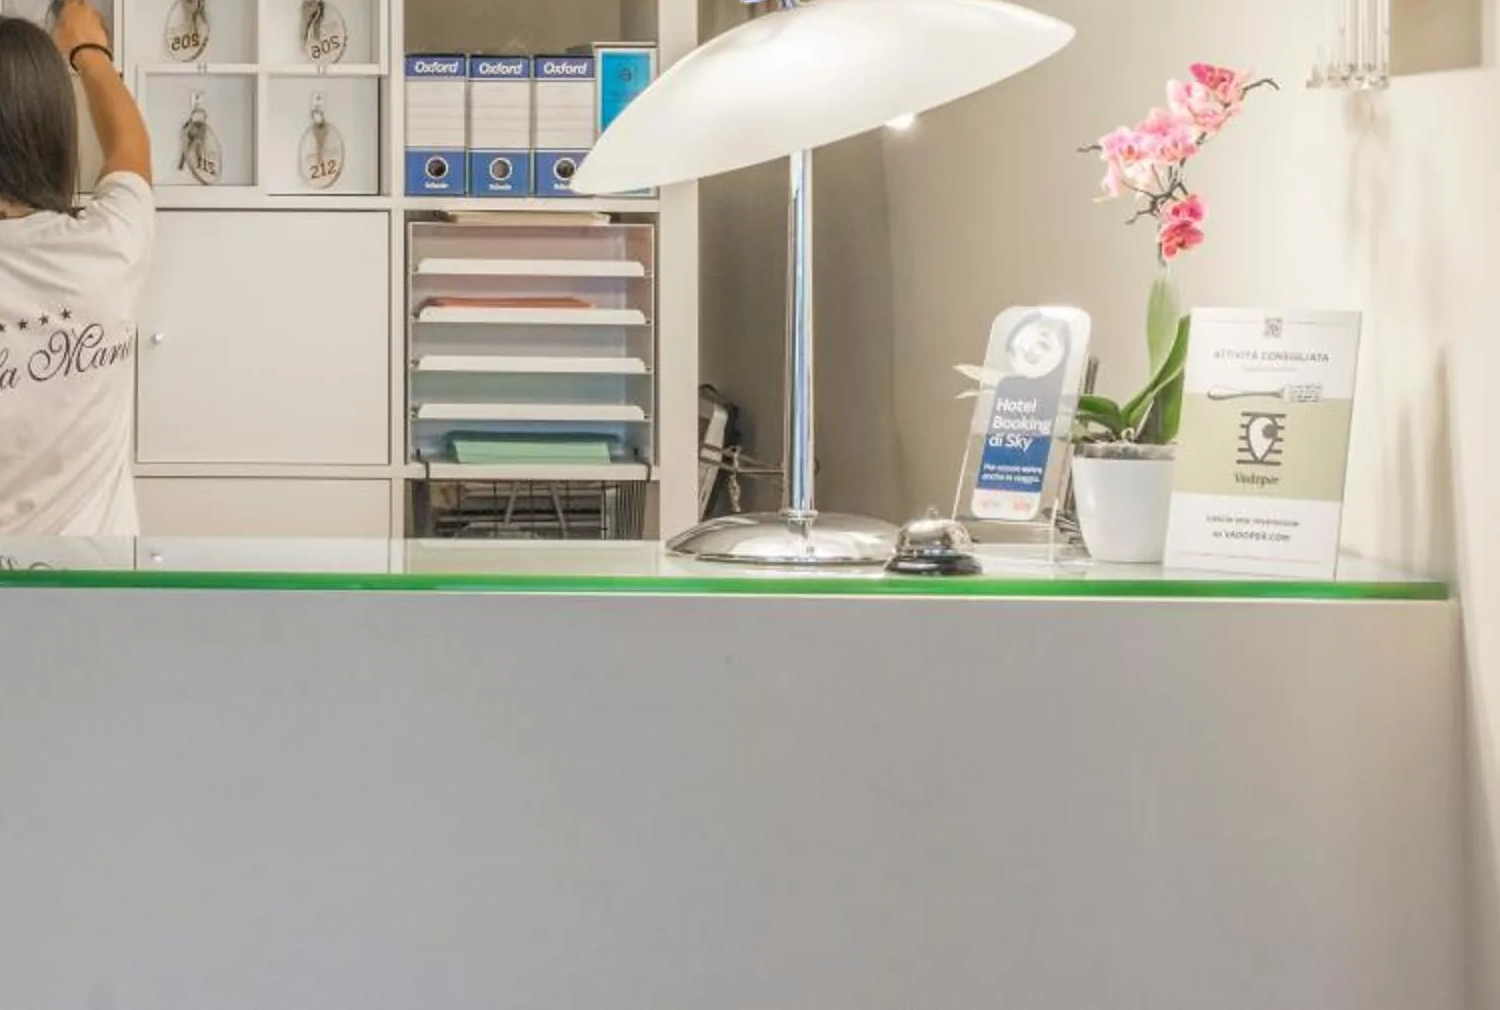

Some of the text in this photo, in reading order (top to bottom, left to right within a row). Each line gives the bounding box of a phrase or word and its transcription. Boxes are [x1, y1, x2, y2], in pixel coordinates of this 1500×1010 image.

[414, 60, 459, 75] Oxford
[478, 61, 524, 76] Oxford
[543, 61, 588, 76] Oxford
[308, 159, 338, 180] 212
[27, 322, 131, 383] Mari
[995, 397, 1038, 412] Hotel
[992, 415, 1053, 436] Booking
[988, 433, 1035, 453] di Sky
